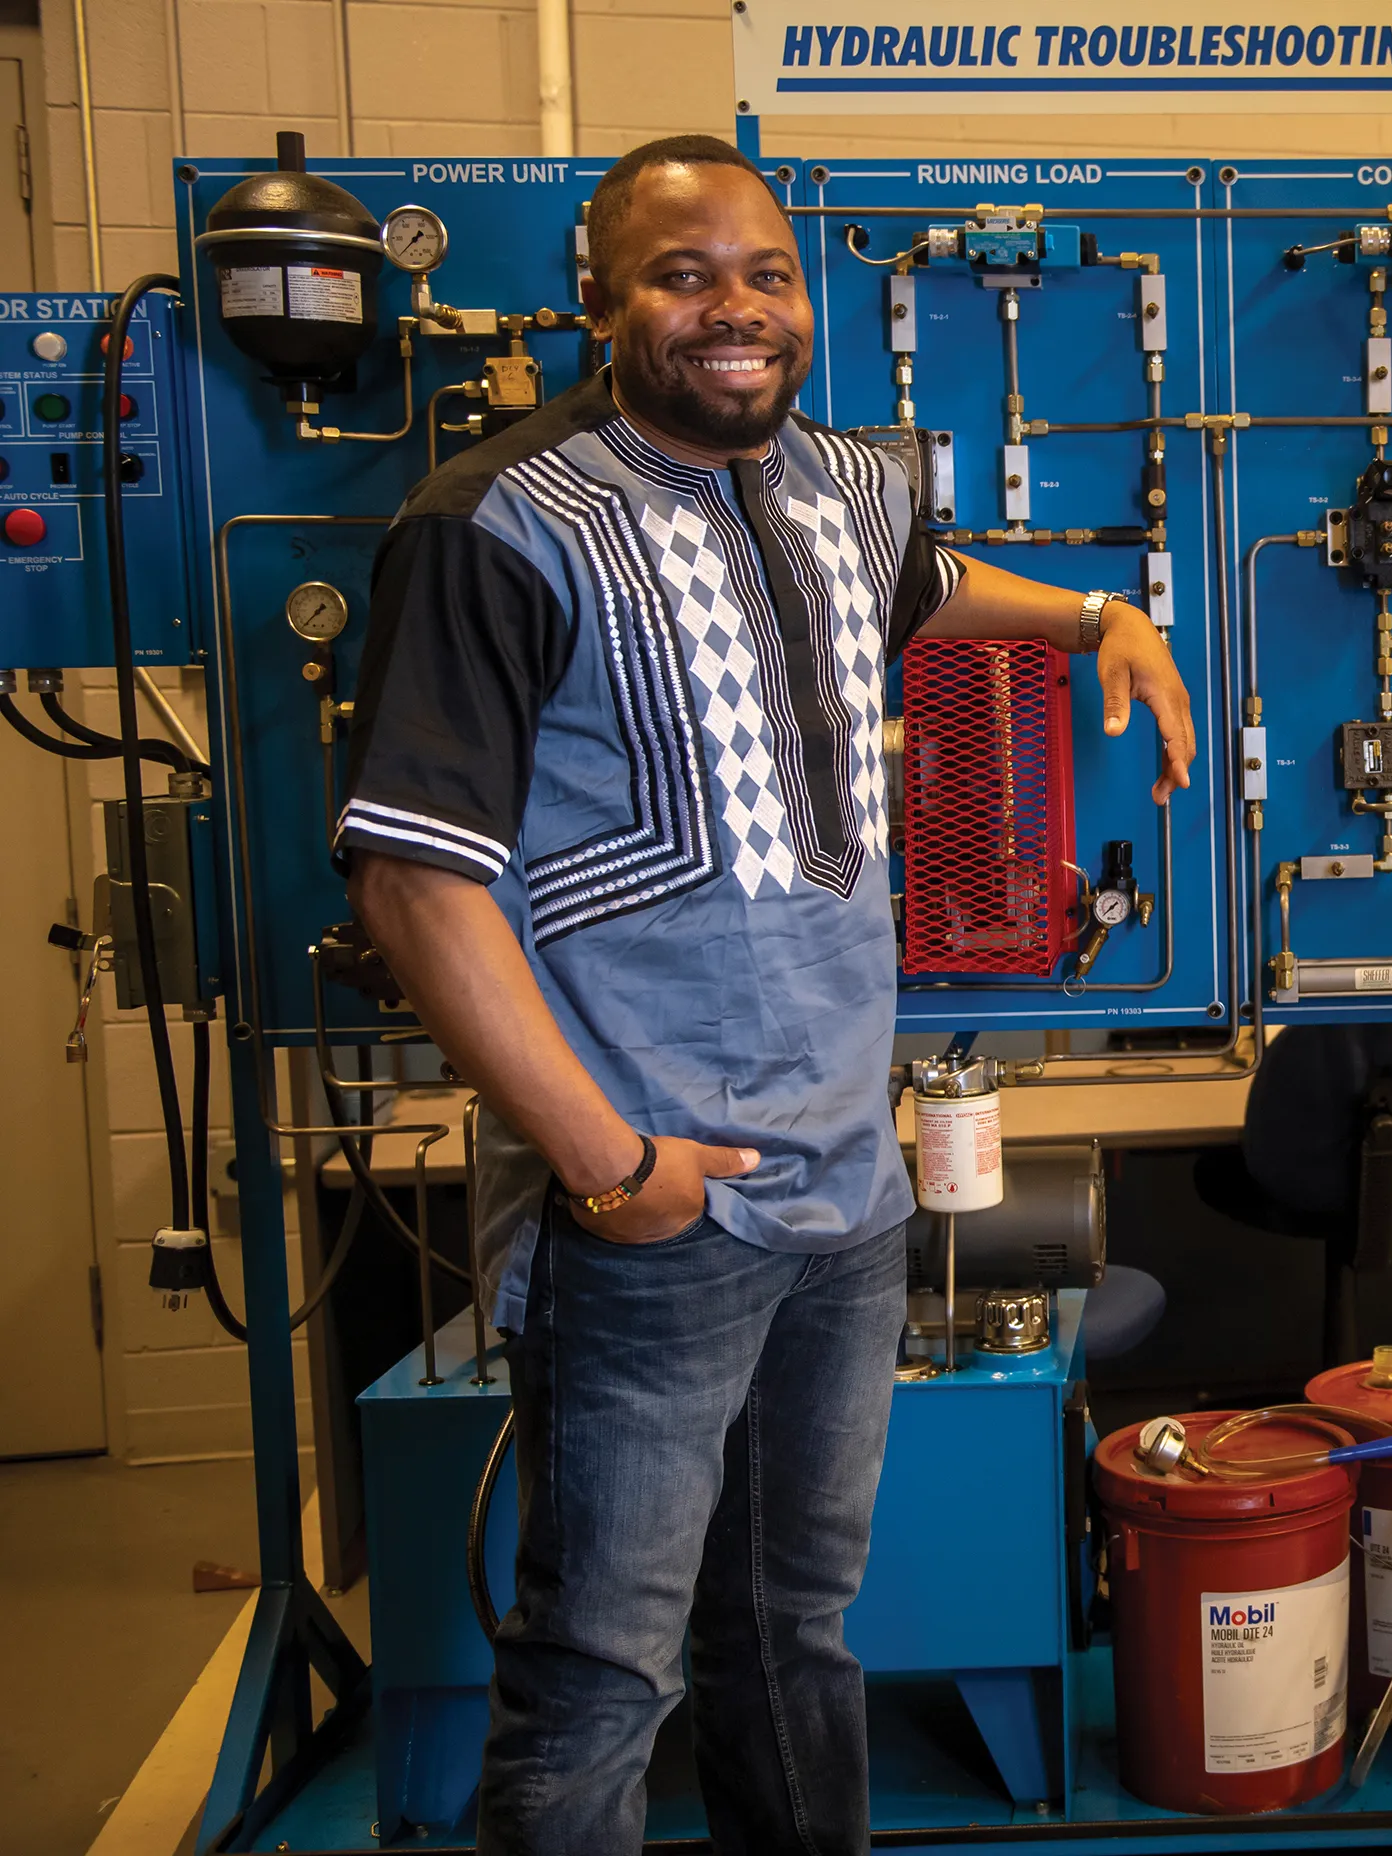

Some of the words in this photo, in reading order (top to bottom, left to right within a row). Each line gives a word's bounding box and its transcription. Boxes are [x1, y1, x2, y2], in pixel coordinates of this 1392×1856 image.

[783, 25, 1020, 68] HYDRAULIC
[412, 164, 505, 184] POWER
[512, 163, 569, 183] UNIT
[917, 164, 1028, 185] RUNNING
[1036, 164, 1103, 184] LOAD
[23, 371, 58, 379] STATUS
[58, 432, 83, 440] PUMP
[85, 432, 128, 440] CONL
[4, 493, 28, 501] AUTO
[8, 556, 64, 565] EMERGENCY
[25, 565, 49, 573] STOP
[1363, 969, 1390, 982] SHEFFER
[1210, 1602, 1275, 1626] Mobil
[1211, 1628, 1240, 1641] MOBIL
[1243, 1627, 1259, 1640] DTE
[1262, 1625, 1274, 1638] 24
